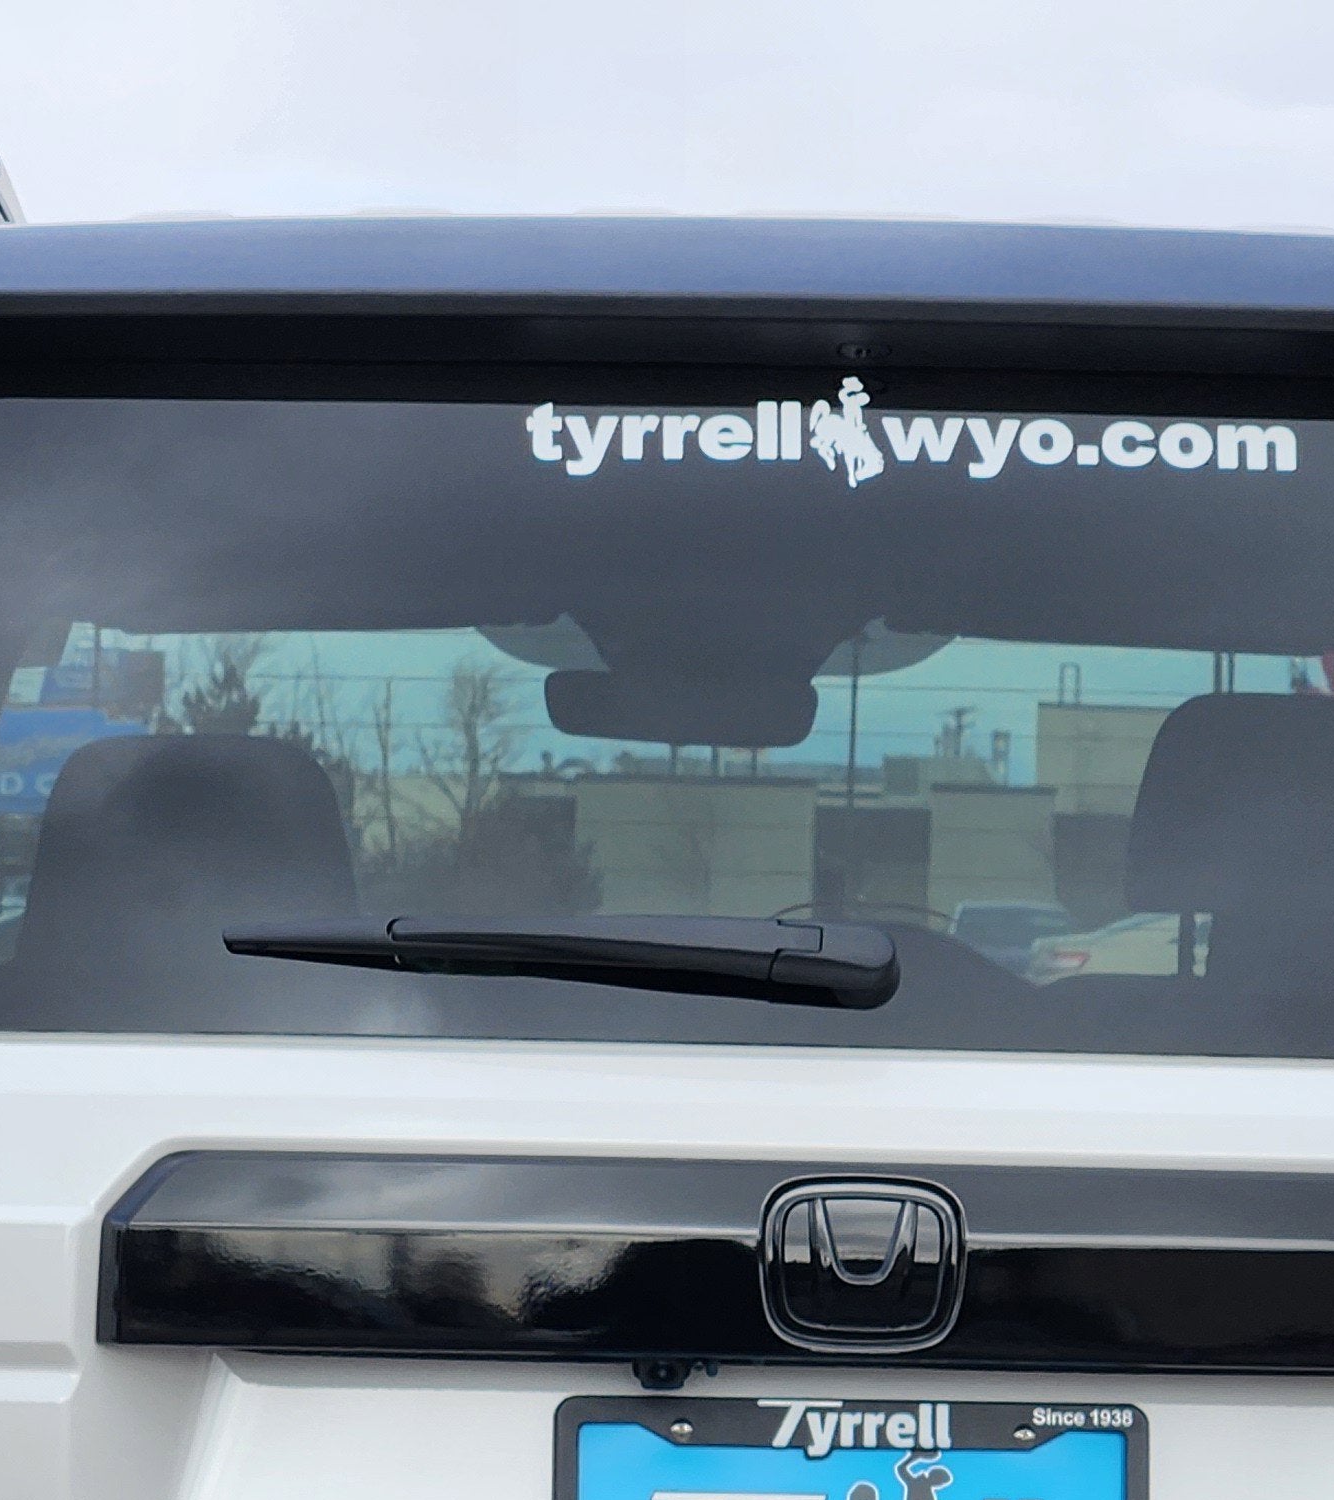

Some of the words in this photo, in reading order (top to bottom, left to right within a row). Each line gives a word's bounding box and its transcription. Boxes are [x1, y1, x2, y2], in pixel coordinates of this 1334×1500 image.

[757, 1399, 952, 1457] Tyrrell
[1032, 1407, 1085, 1428] Since
[1089, 1409, 1134, 1428] 1938
